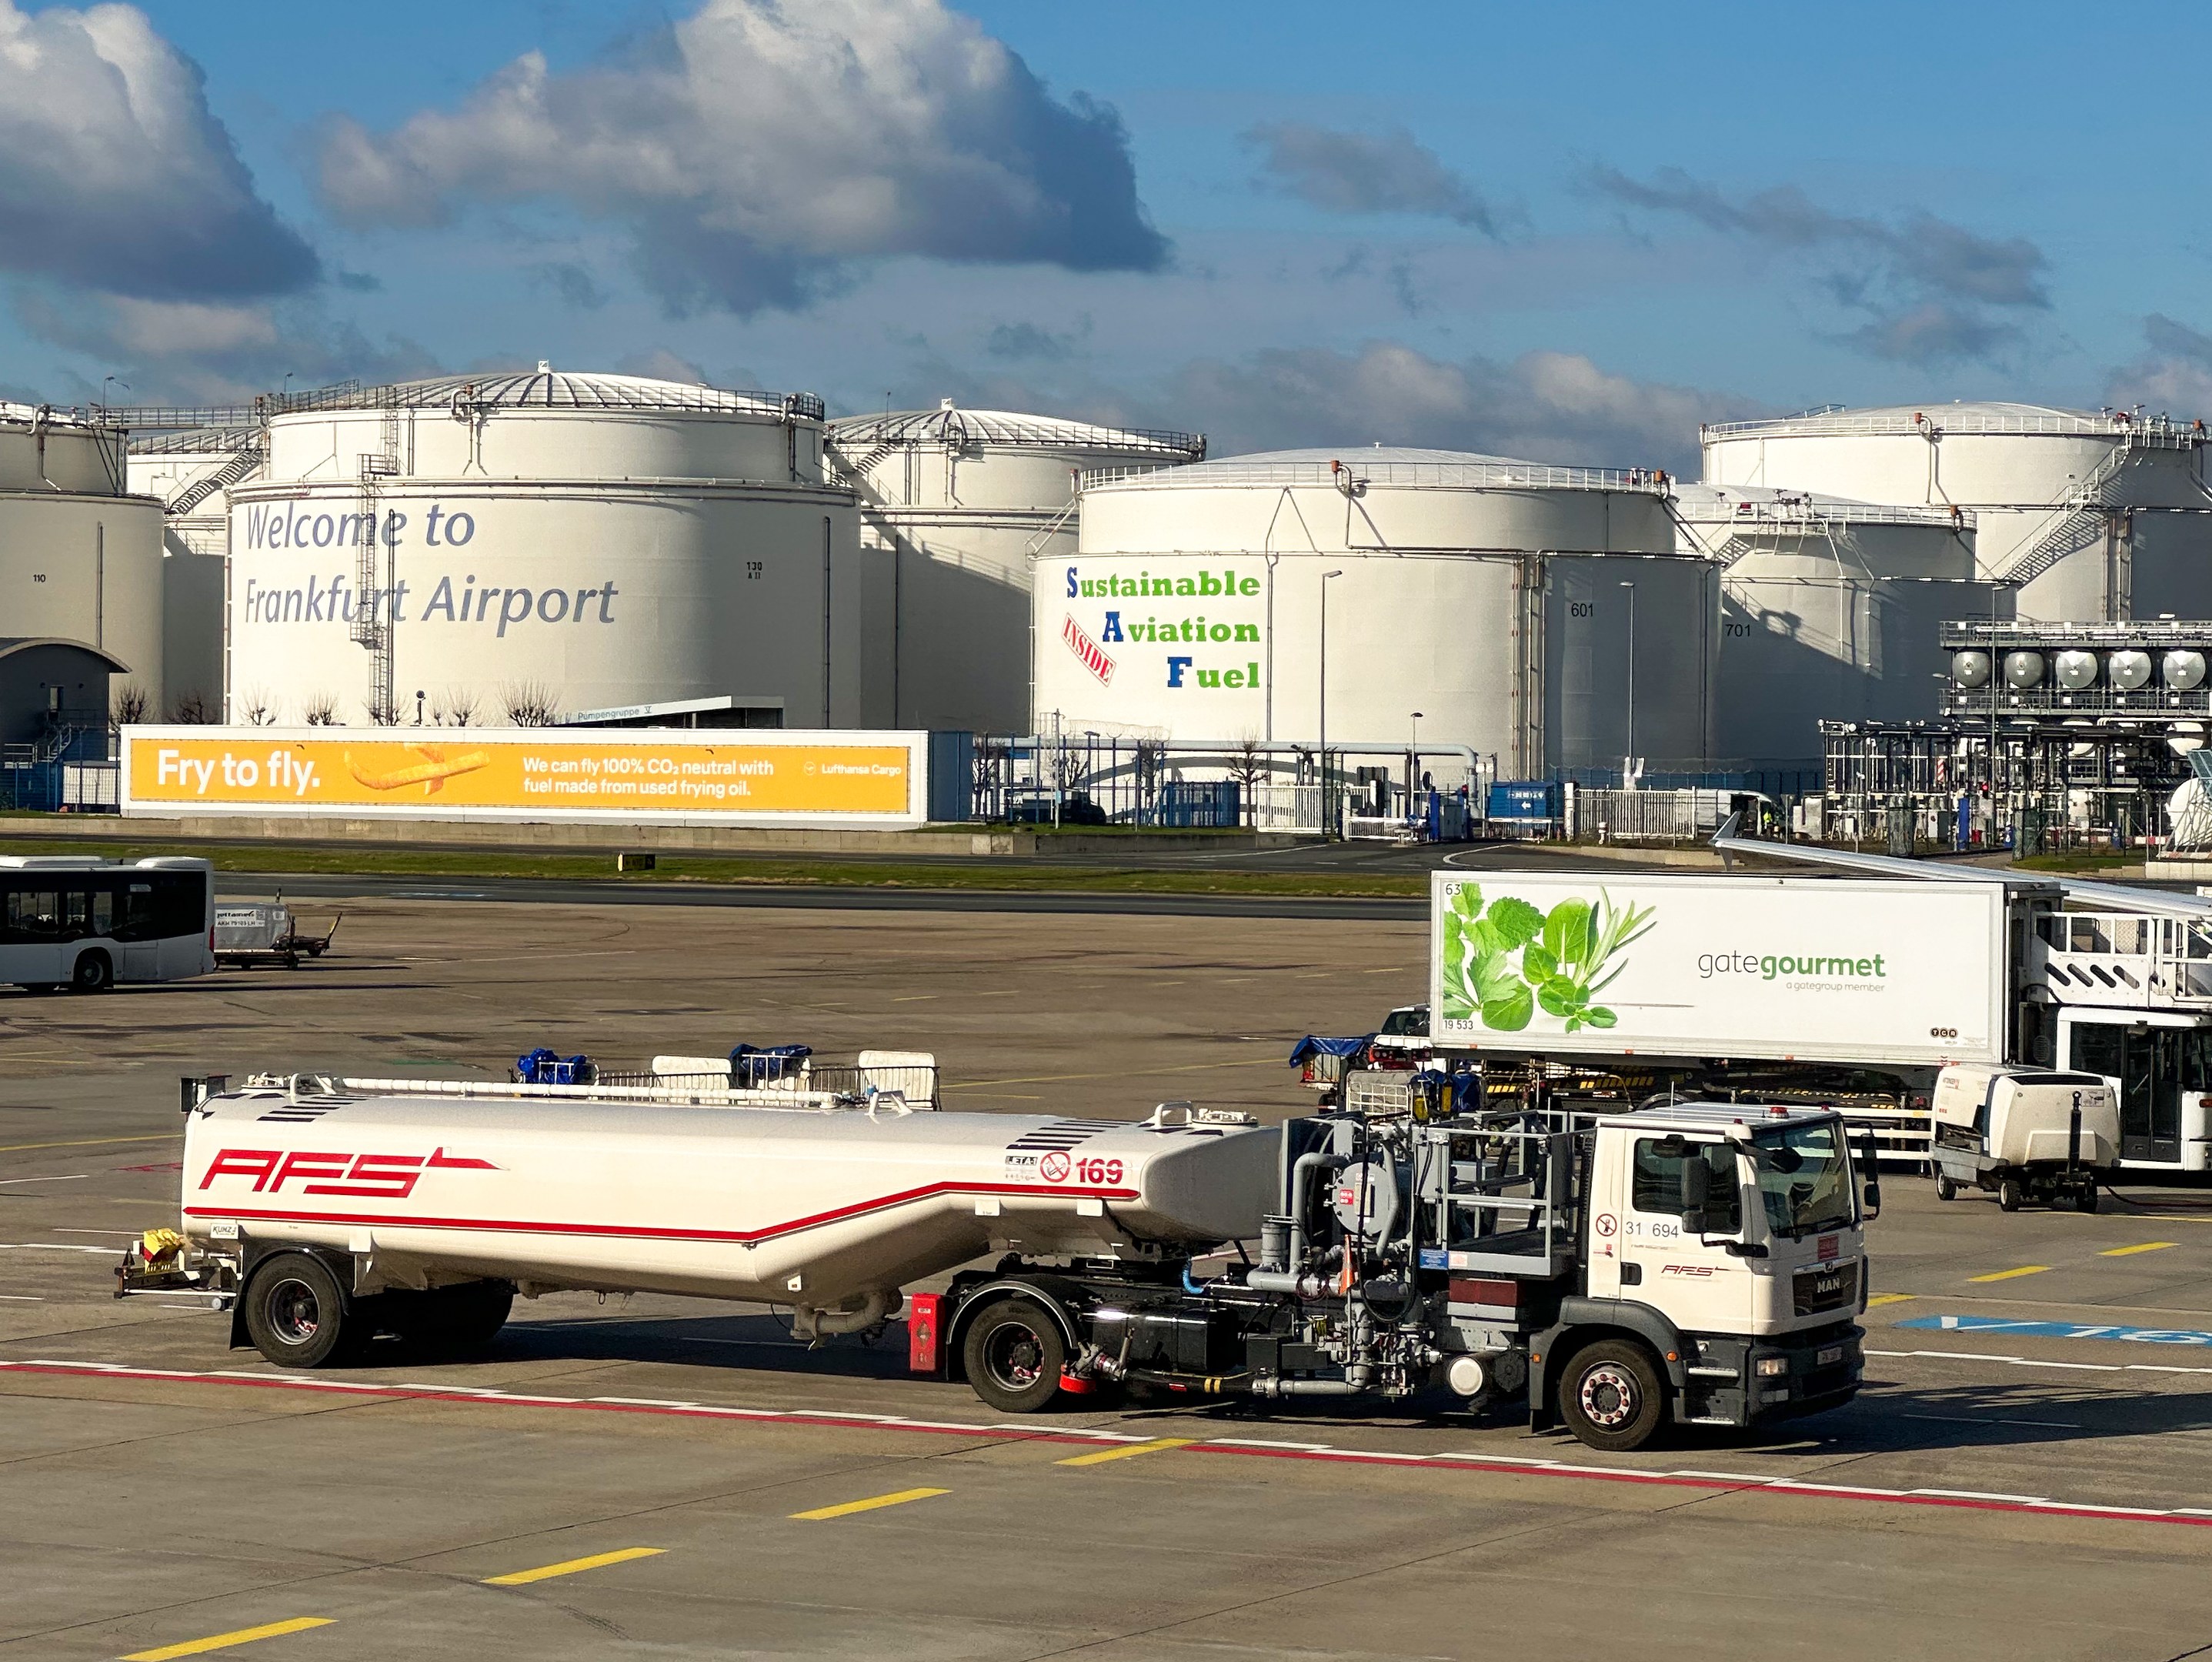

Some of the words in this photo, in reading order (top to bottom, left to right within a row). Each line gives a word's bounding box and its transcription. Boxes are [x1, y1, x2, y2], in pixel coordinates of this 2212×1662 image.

[248, 501, 408, 549] Welcome
[425, 503, 475, 546] to
[746, 562, 762, 571] 130
[32, 574, 46, 583] 110
[1066, 566, 1261, 598] Sustainable
[245, 575, 410, 622] Frankfurt
[420, 575, 619, 638] Airport
[1570, 602, 1594, 618] 601
[1103, 611, 1260, 642] Aviation
[1725, 623, 1750, 637] 701
[1062, 616, 1115, 683] INSIDE
[1167, 656, 1260, 688] Fuel
[578, 709, 639, 720] Pumpengruppe
[158, 749, 216, 795] Fry
[222, 753, 259, 787] to
[267, 750, 321, 796] fly.
[522, 757, 549, 773] We
[551, 760, 578, 773] can
[581, 758, 601, 776] fly
[602, 758, 645, 774] 100%
[682, 760, 736, 775] neutral
[739, 760, 774, 776] with
[821, 763, 869, 775] Lufthansa
[871, 763, 902, 777] Cargo
[523, 777, 552, 793] fuel
[555, 779, 598, 794] made
[600, 778, 637, 794] from
[639, 779, 677, 795] used
[680, 779, 726, 799] frying
[728, 780, 752, 796] oil.
[1446, 883, 1461, 895] 63
[1697, 949, 1887, 980] gategourmet
[1793, 982, 1843, 993] gategroup
[1844, 983, 1885, 992] member
[1444, 1020, 1453, 1030] 19
[1456, 1020, 1473, 1030] 533
[199, 1148, 425, 1198] AFS
[1076, 1158, 1123, 1185] 169
[1625, 1221, 1642, 1235] 31
[1652, 1223, 1679, 1238] 694
[1660, 1264, 1717, 1277] AFS
[1817, 1277, 1841, 1293] MAN
